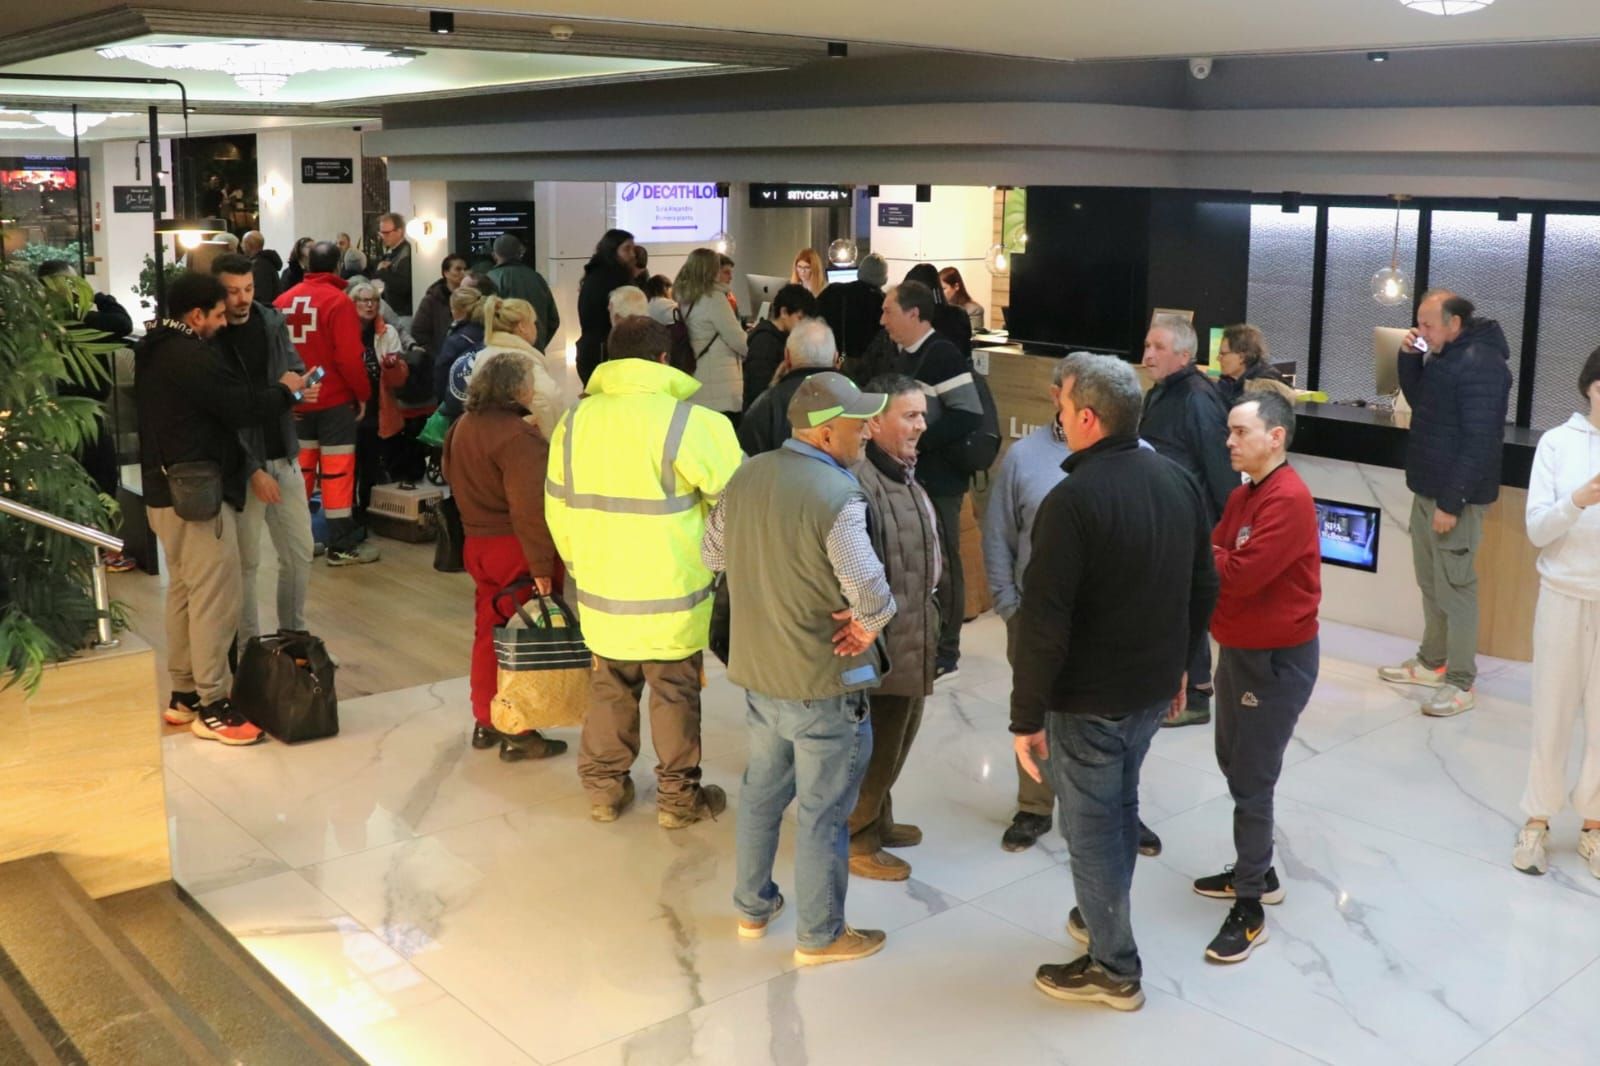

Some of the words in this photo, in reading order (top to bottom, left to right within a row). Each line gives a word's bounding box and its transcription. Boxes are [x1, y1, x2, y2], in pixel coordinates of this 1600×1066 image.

[162, 318, 193, 335] PUMA
[1010, 416, 1041, 438] Lu
[1324, 521, 1342, 533] SPA
